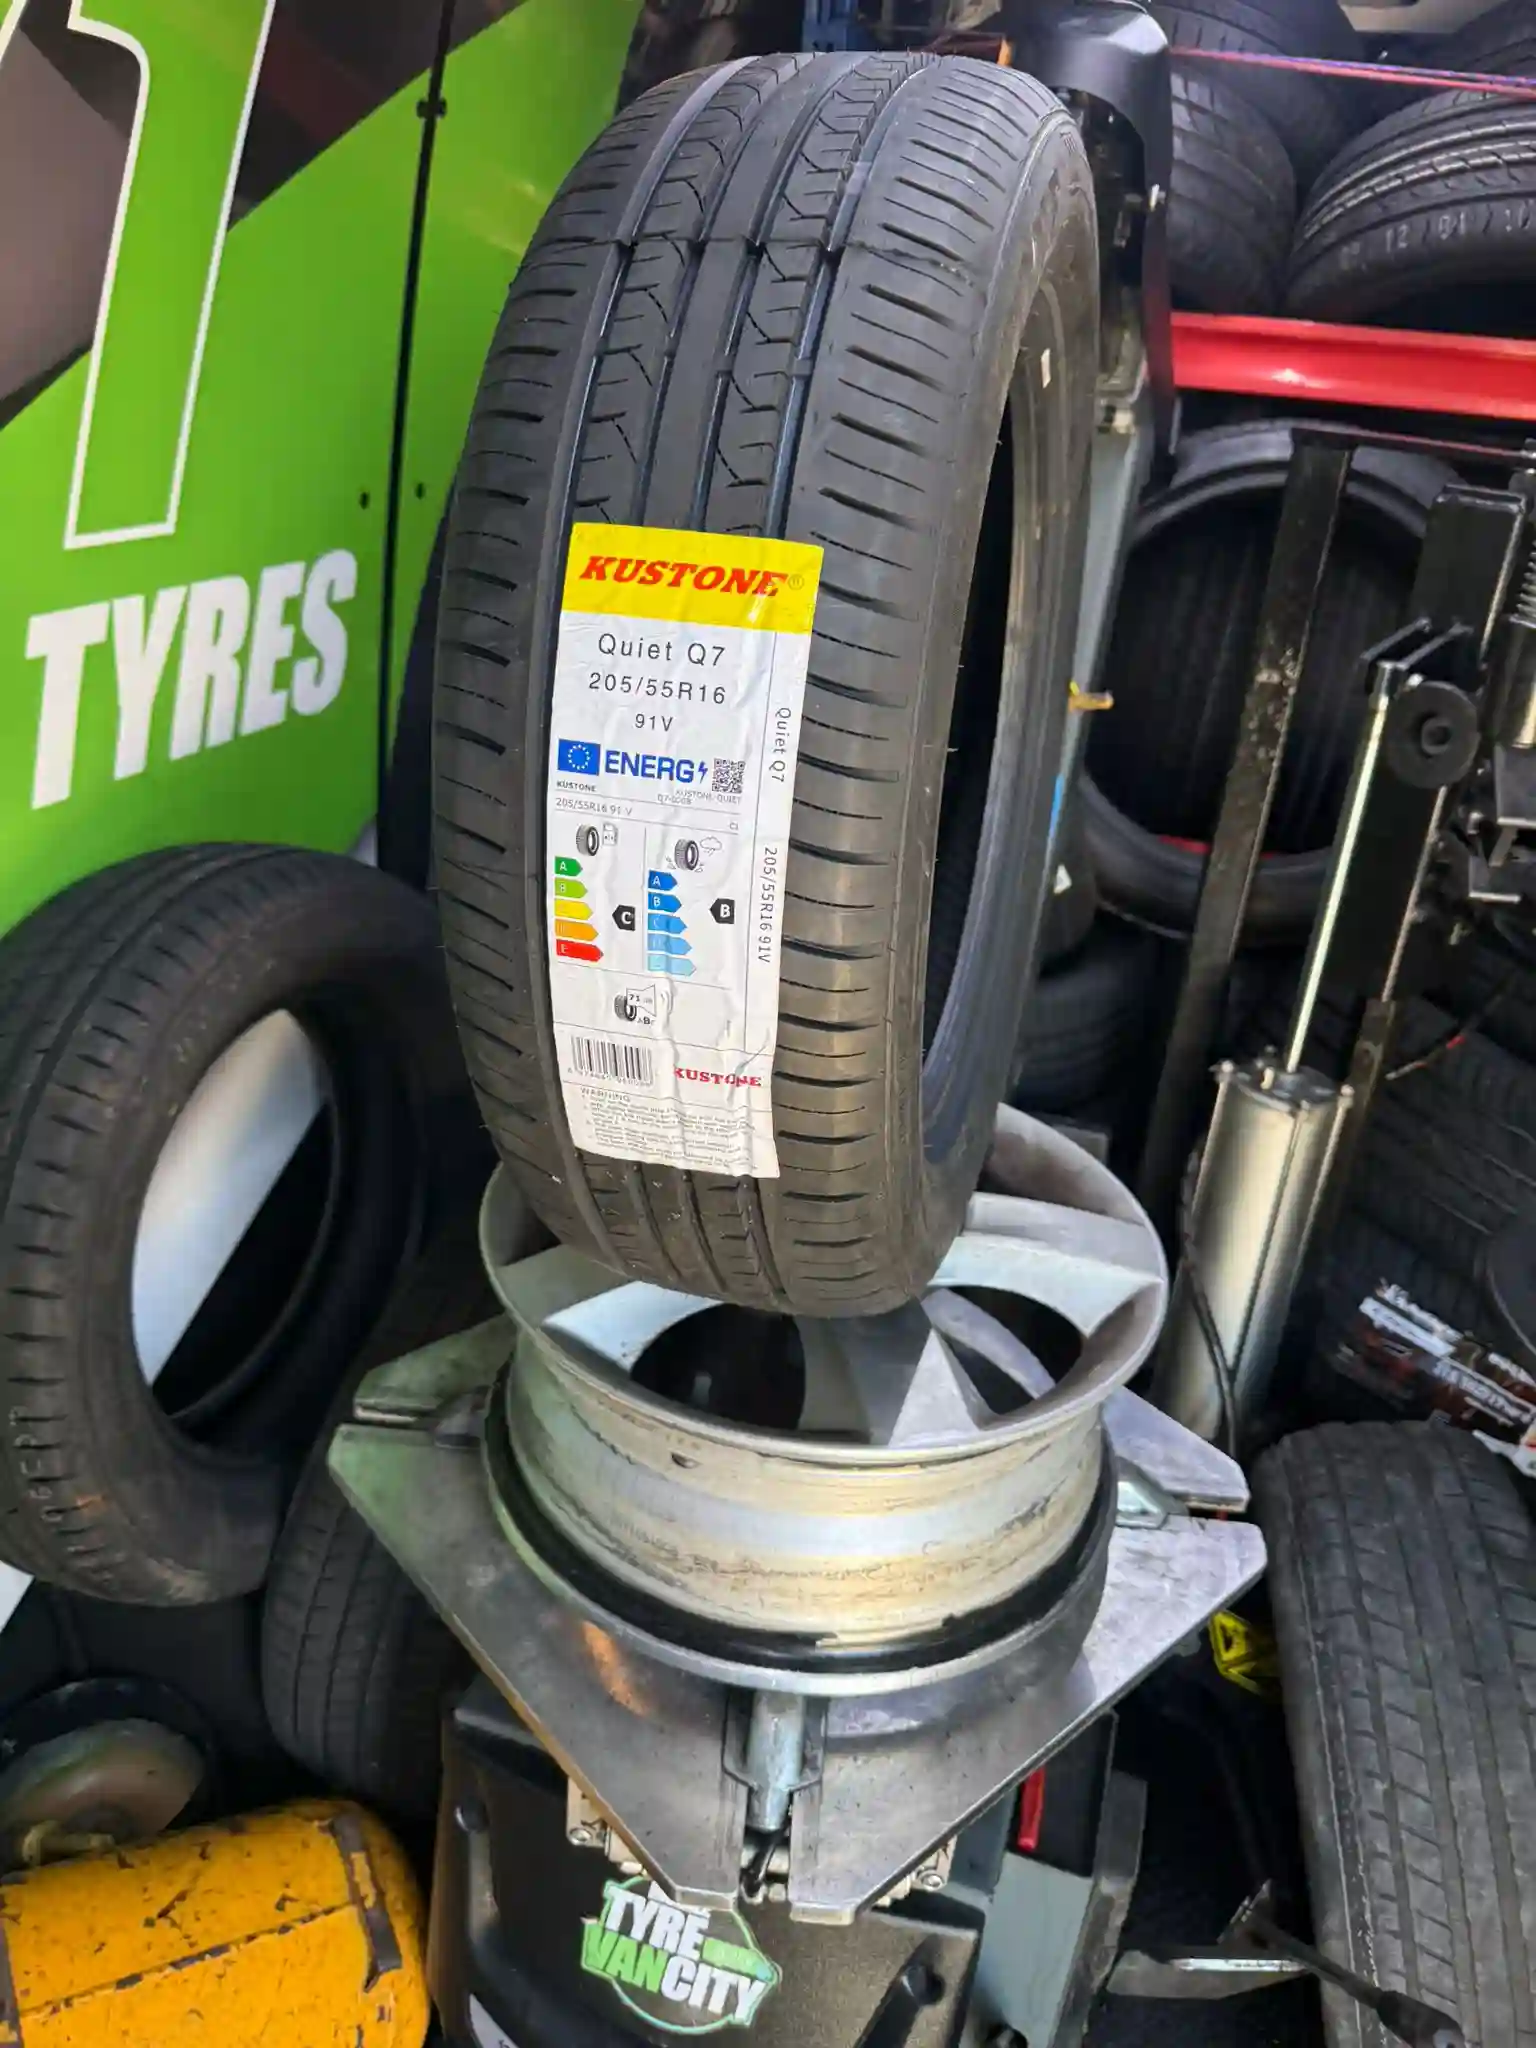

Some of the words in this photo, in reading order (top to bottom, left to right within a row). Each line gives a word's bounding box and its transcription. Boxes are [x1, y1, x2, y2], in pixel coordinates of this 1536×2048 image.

[580, 556, 788, 597] KUSTONE
[598, 633, 673, 661] Quiet
[687, 642, 726, 667] Q7
[25, 549, 357, 810] TYRES
[589, 672, 726, 704] 205/55R16
[635, 713, 673, 732] 91V
[772, 707, 791, 754] Quiet
[768, 759, 787, 783] Q7
[556, 780, 597, 793] KUSTONE
[556, 797, 608, 813] 205/55R16
[559, 861, 568, 872] A
[653, 875, 661, 886] A
[759, 847, 778, 932] 205/55R16
[653, 896, 661, 907] B
[719, 904, 731, 918] B
[620, 912, 632, 925] C
[757, 934, 773, 963] 91V
[605, 1885, 711, 1961] TYRE
